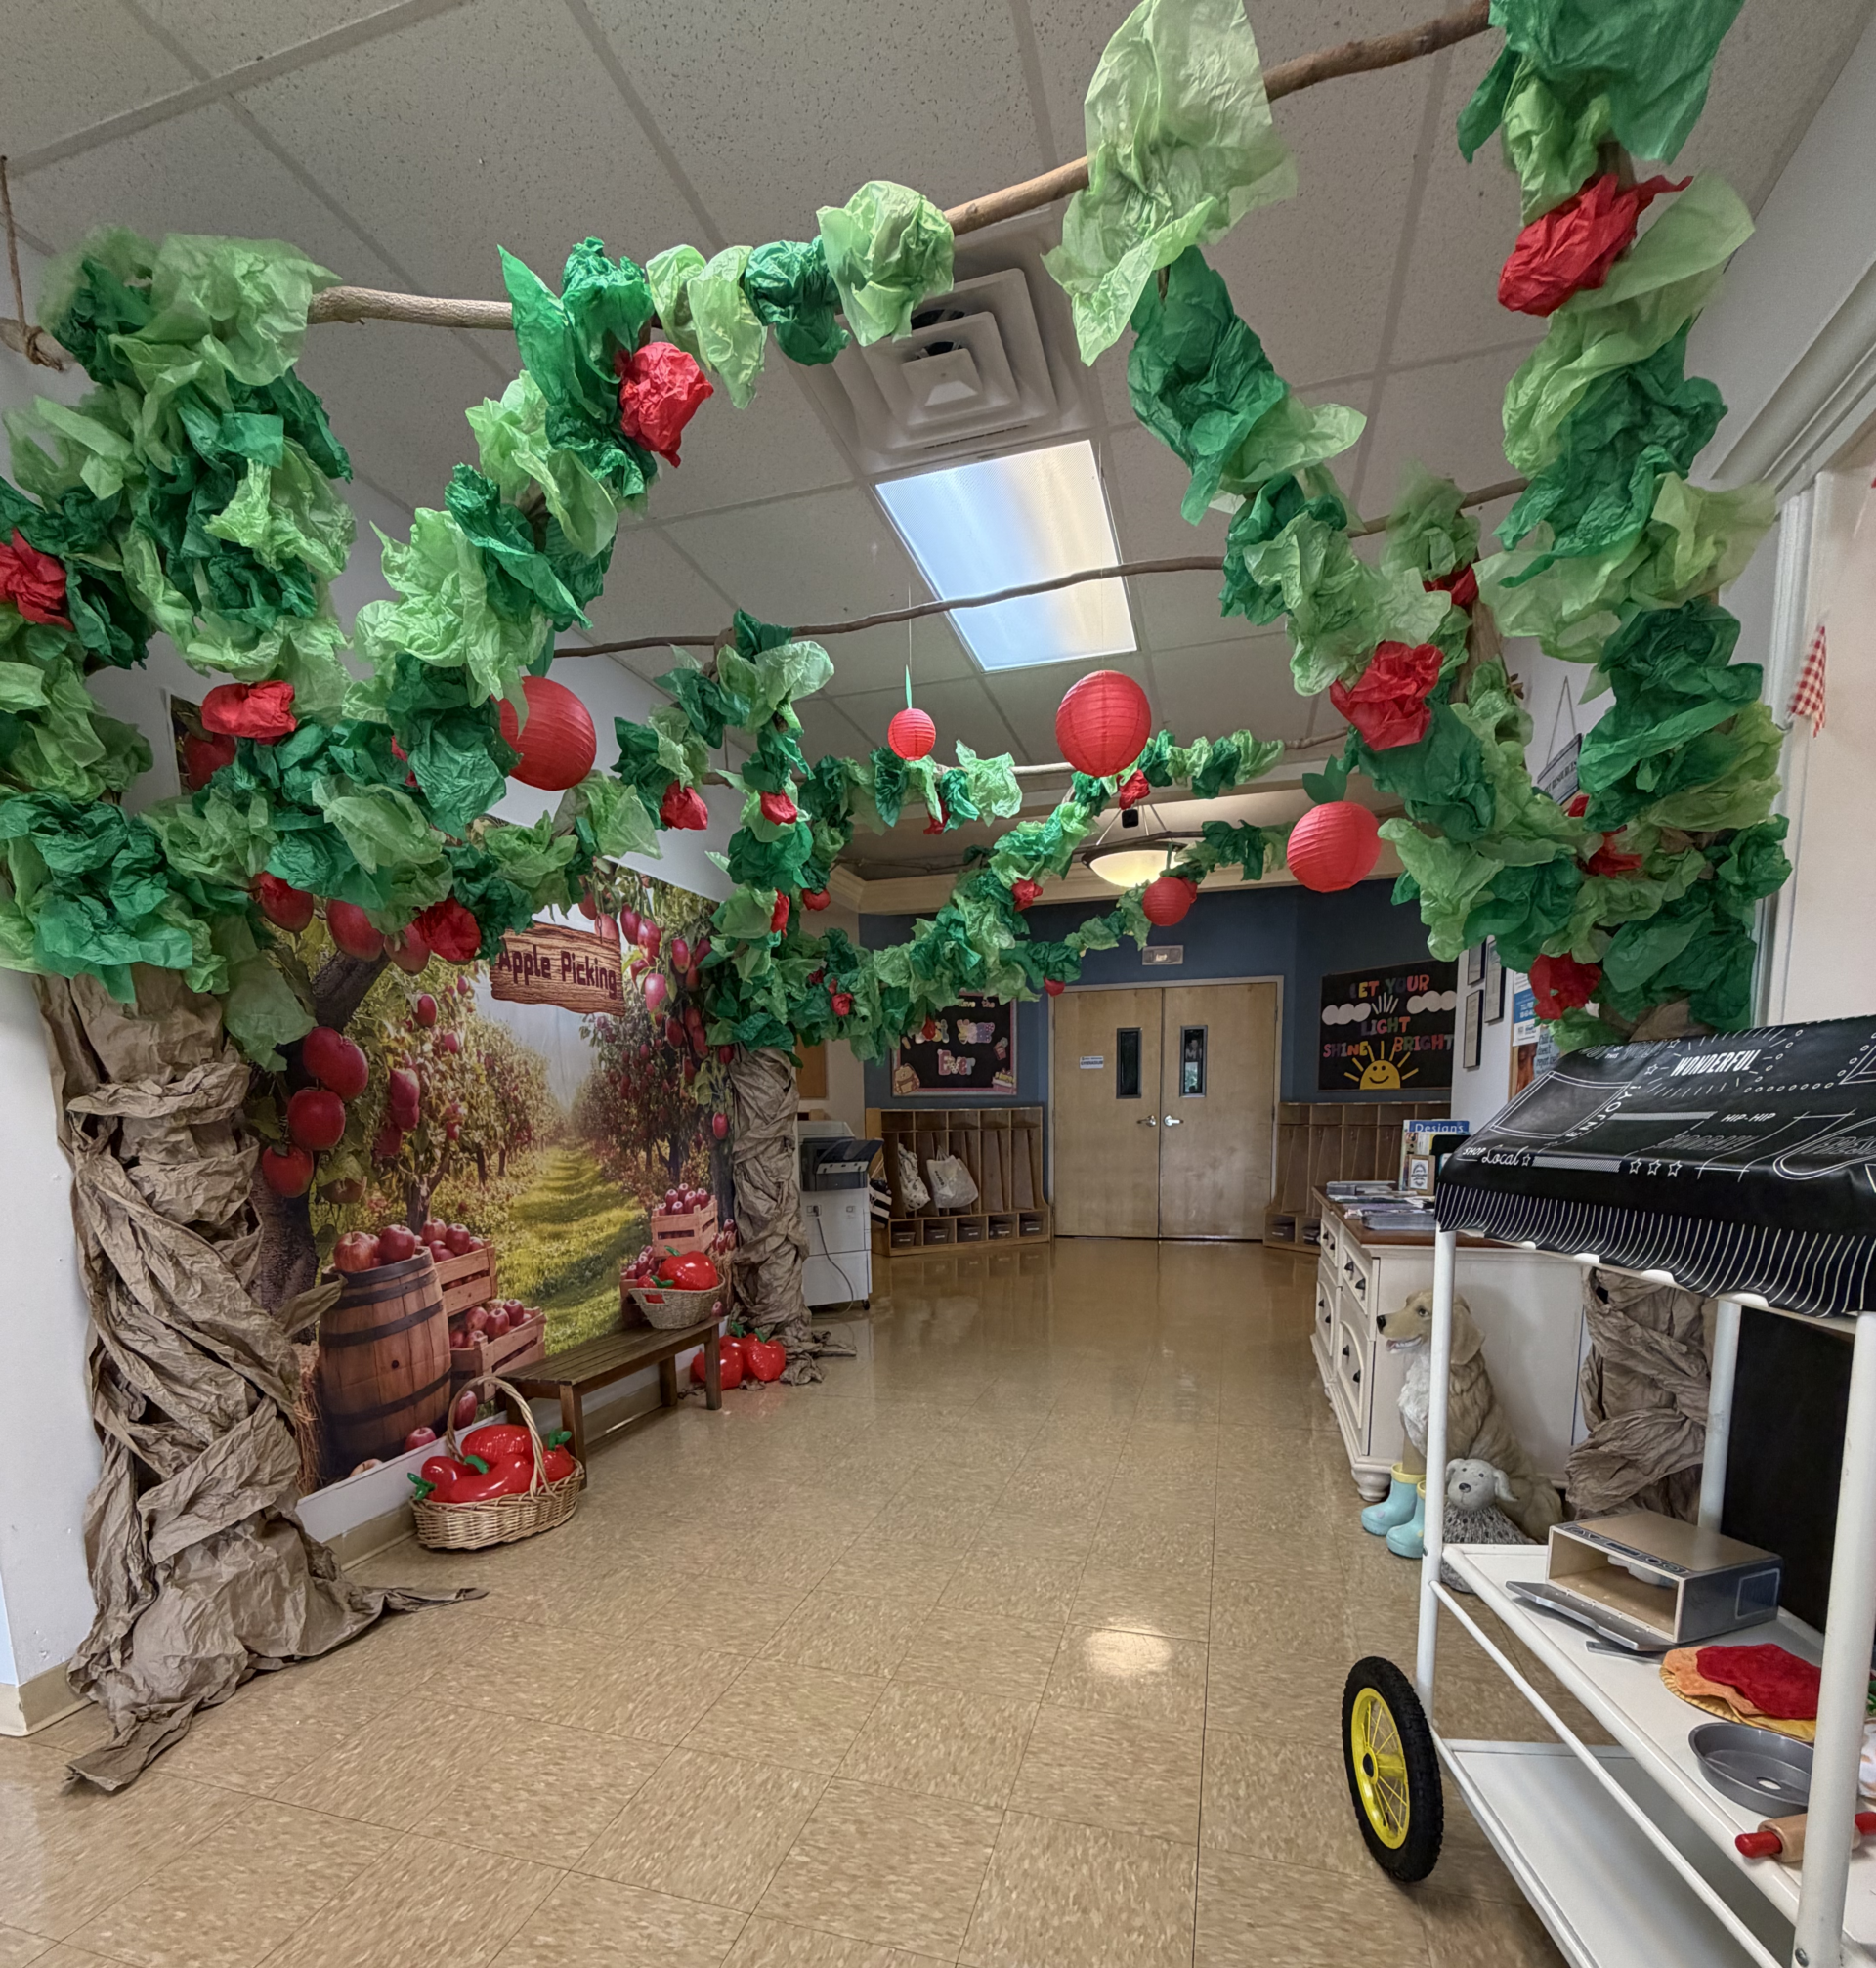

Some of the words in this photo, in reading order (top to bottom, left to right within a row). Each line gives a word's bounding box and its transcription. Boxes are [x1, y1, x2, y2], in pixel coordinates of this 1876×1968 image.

[498, 938, 551, 986] Apple
[561, 950, 618, 1000] Picking
[1349, 980, 1380, 999] LET
[1384, 974, 1430, 995] YOUR
[1360, 1016, 1411, 1037] LIGHT
[1323, 1040, 1369, 1058] SHINE
[1393, 1034, 1454, 1053] BRIGHT
[1670, 1049, 1761, 1077] WONDERFUL
[1565, 1085, 1642, 1137] ENJOY!
[1721, 1112, 1776, 1123] HIP-HIP
[1415, 1123, 1465, 1133] Designs
[1462, 1146, 1486, 1156] SHOP
[1481, 1143, 1529, 1167] Local
